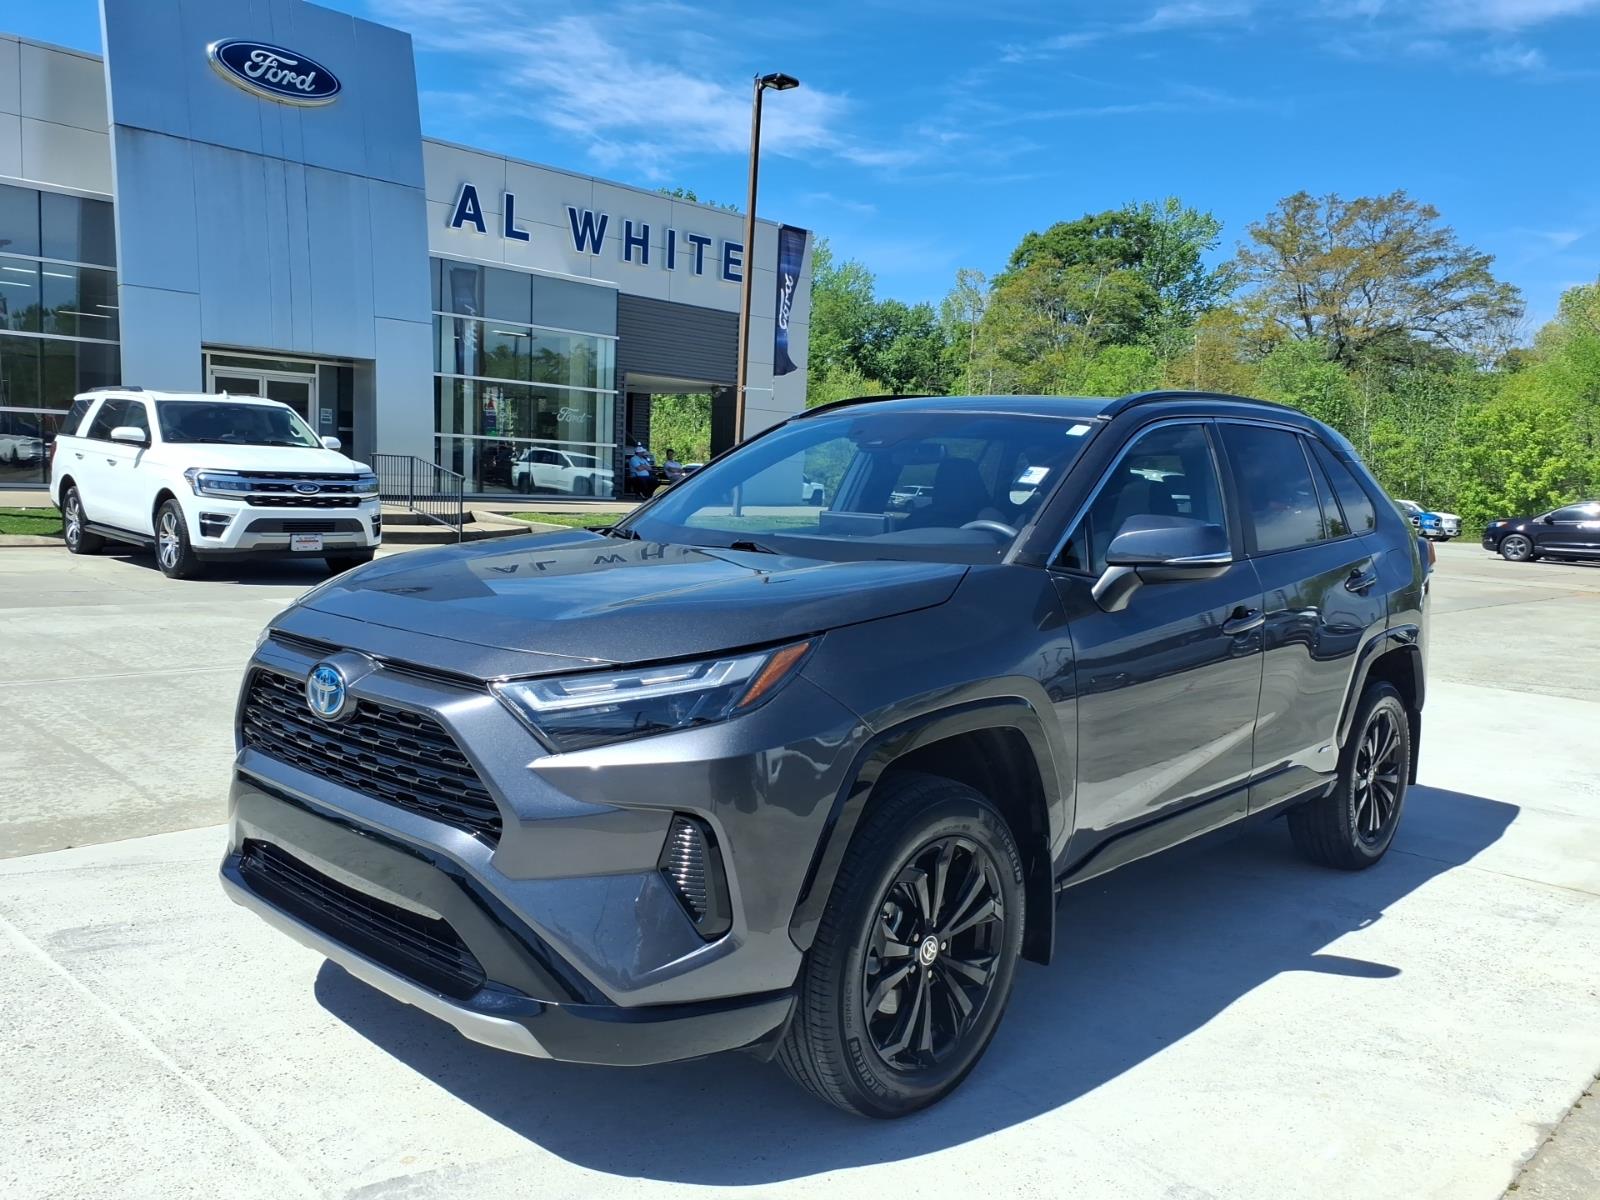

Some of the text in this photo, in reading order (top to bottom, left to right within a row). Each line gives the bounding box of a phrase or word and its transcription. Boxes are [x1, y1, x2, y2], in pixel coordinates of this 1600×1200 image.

[244, 50, 317, 91] Ford
[450, 183, 744, 282] AL WHITE
[779, 273, 794, 329] Ford
[556, 407, 586, 423] Ford
[850, 1040, 887, 1097] MICHELIN
